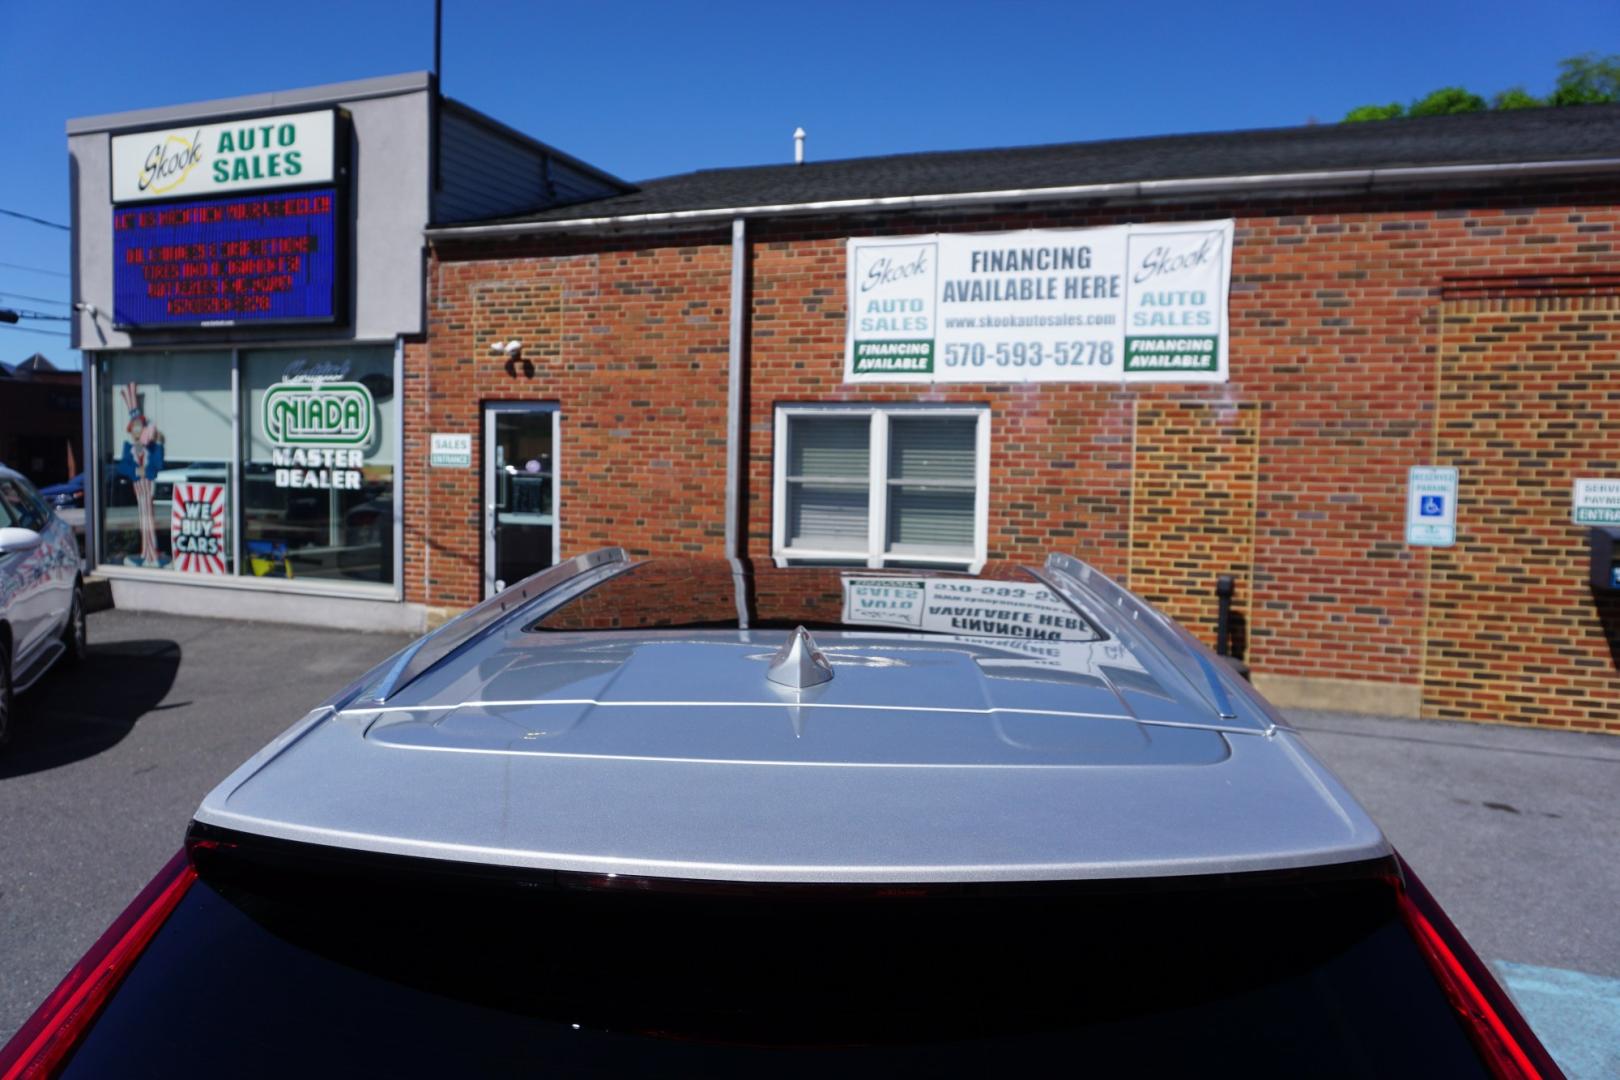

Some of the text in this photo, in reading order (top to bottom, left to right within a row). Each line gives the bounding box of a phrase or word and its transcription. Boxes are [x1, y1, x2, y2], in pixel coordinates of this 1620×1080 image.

[217, 123, 296, 154] AUTO
[138, 129, 201, 191] Skook
[213, 151, 302, 183] SALES
[971, 246, 1092, 273] FINANCING
[1133, 237, 1212, 284] Skook
[861, 248, 928, 292] Skook
[942, 274, 1120, 303] AVAILABLE HERE
[866, 298, 924, 314] AUTO
[1140, 290, 1207, 307] AUTO
[861, 316, 929, 332] SALES
[945, 313, 1116, 329] www.skookautosales.com
[1133, 310, 1212, 327] SALES
[858, 342, 930, 357] FINANCING
[944, 340, 1113, 367] 570-593-5278
[1129, 338, 1214, 354] FINANCING
[857, 356, 929, 371] AVAILABLE
[1129, 353, 1212, 369] AVAILABLE
[272, 397, 360, 432] NIADA
[434, 439, 467, 449] SALES
[272, 448, 363, 468] MASTER
[275, 469, 361, 489] DEALER
[185, 502, 211, 519] WE
[182, 519, 213, 536] BUY
[176, 535, 218, 555] CARS
